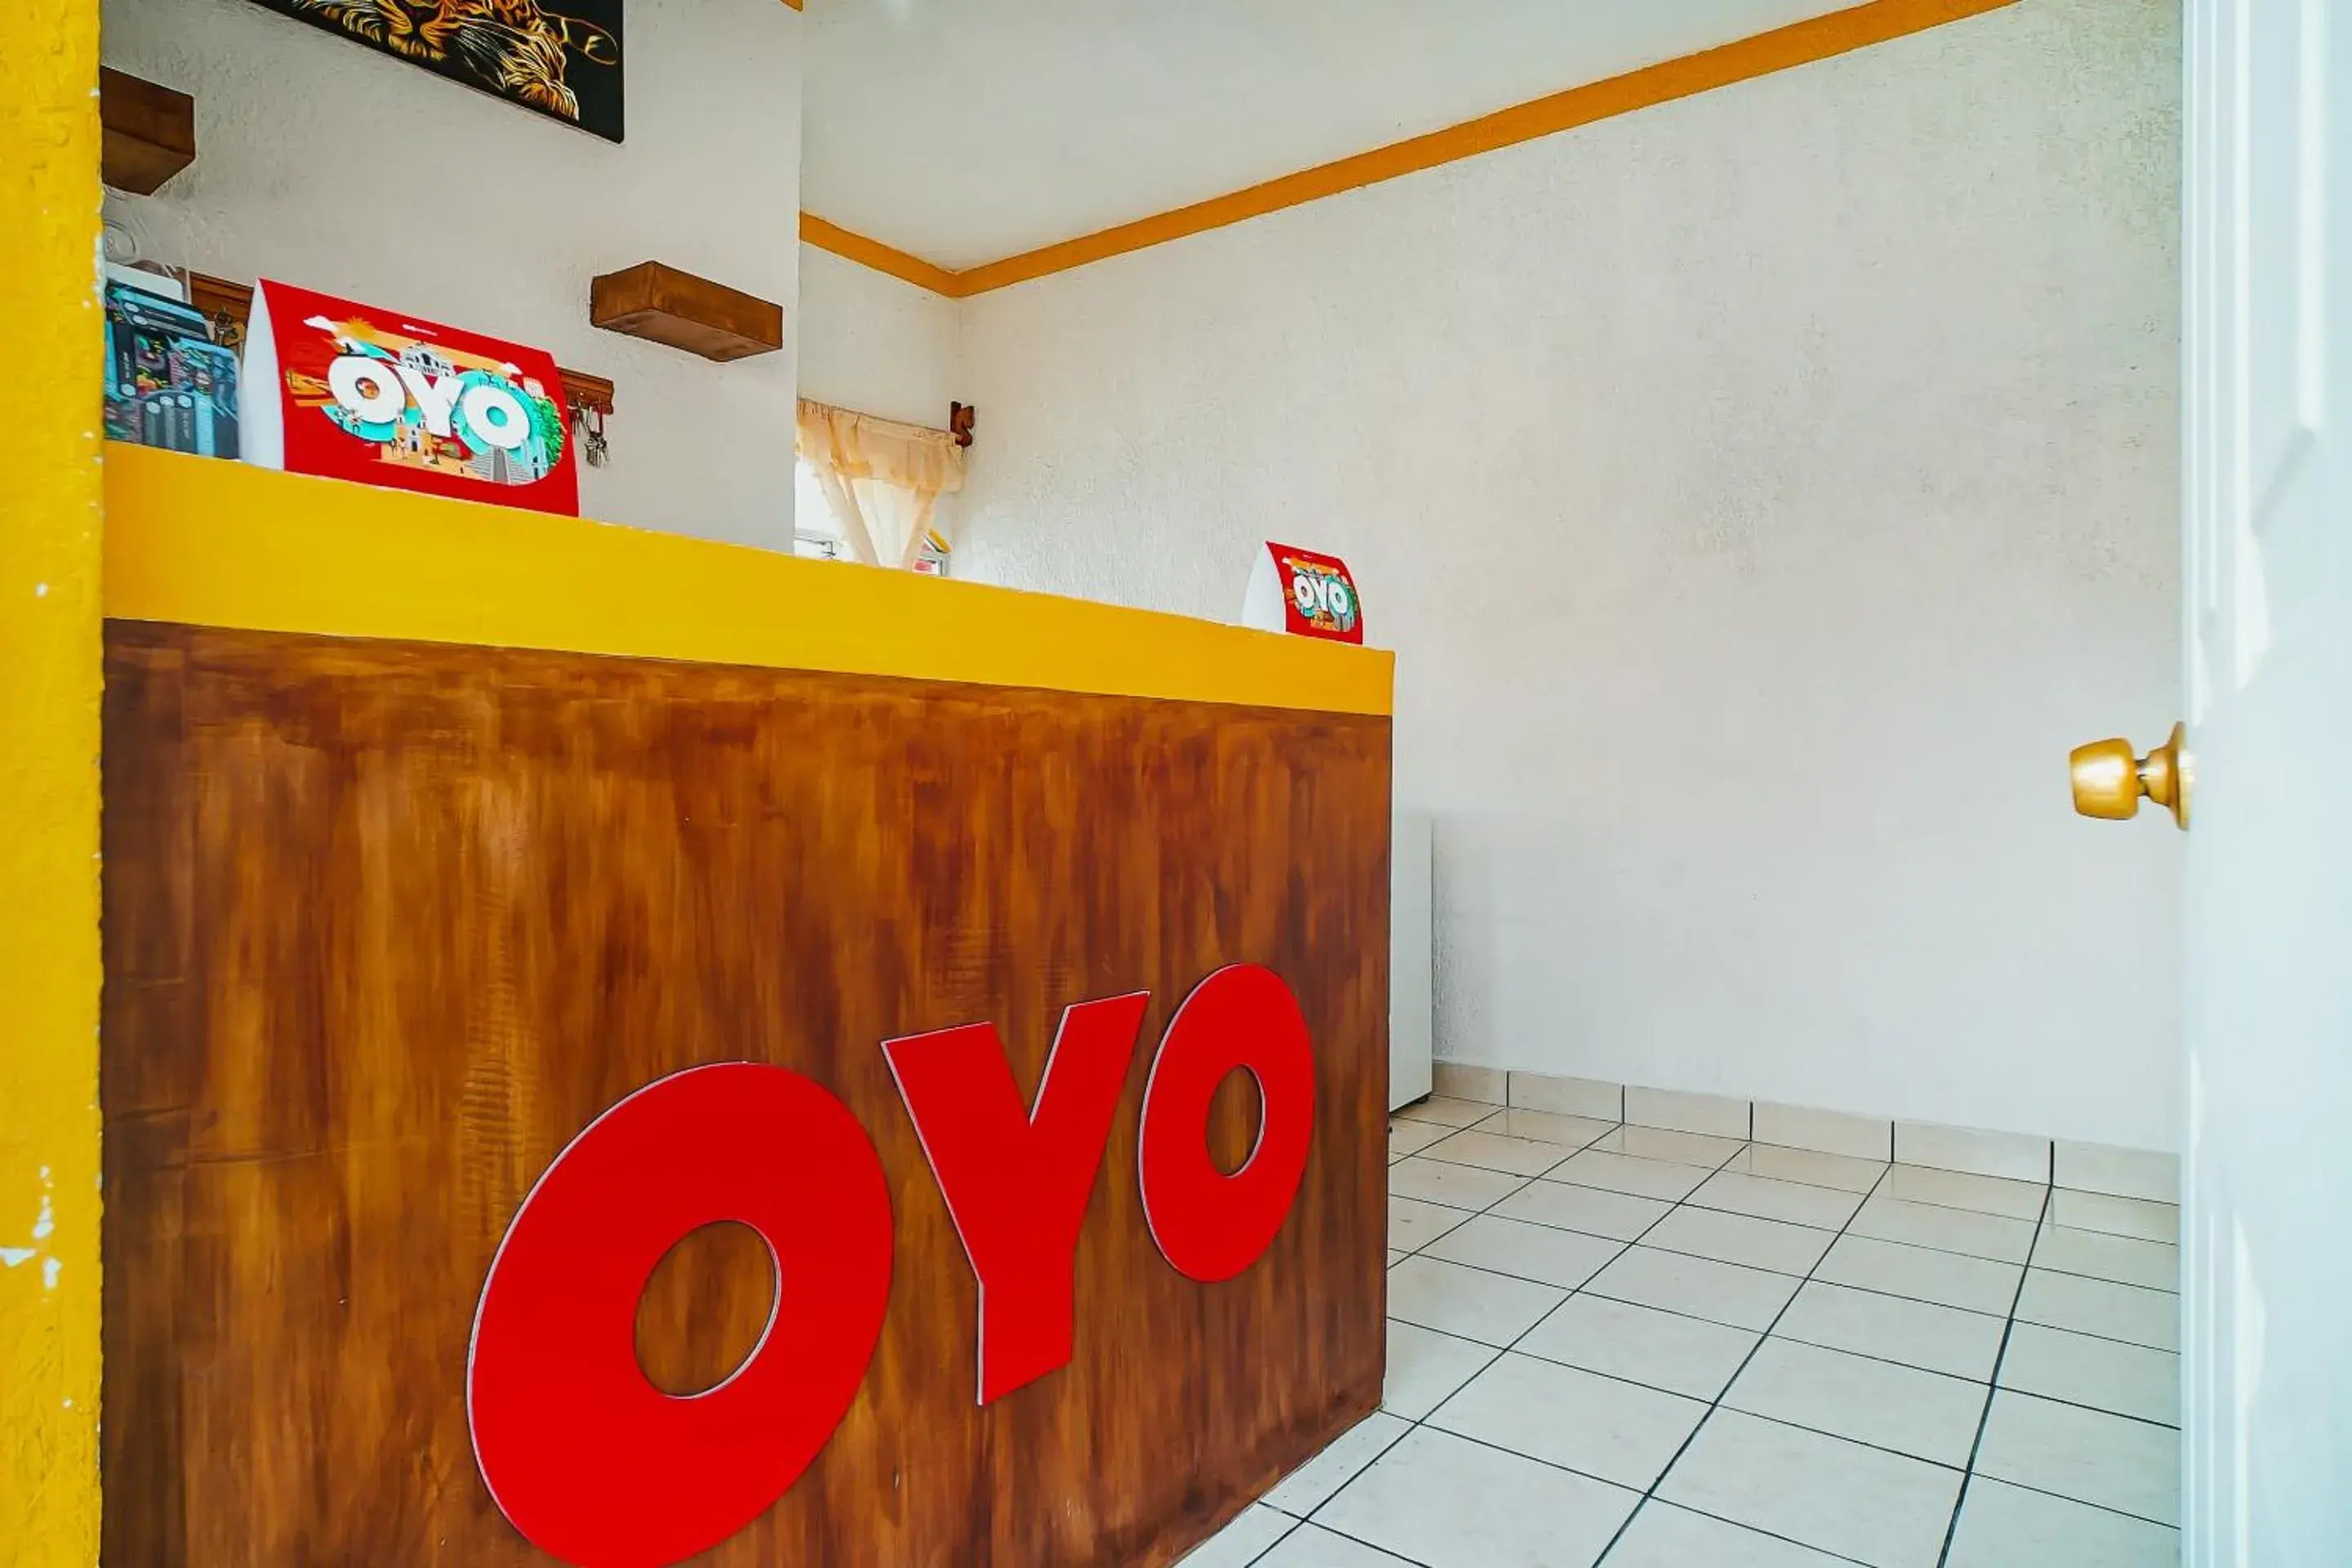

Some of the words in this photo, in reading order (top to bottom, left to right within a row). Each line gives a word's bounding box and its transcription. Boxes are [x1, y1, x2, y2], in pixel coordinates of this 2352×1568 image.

[327, 355, 531, 449] OYO
[1293, 574, 1348, 614] OYO
[466, 962, 1316, 1568] OYO
